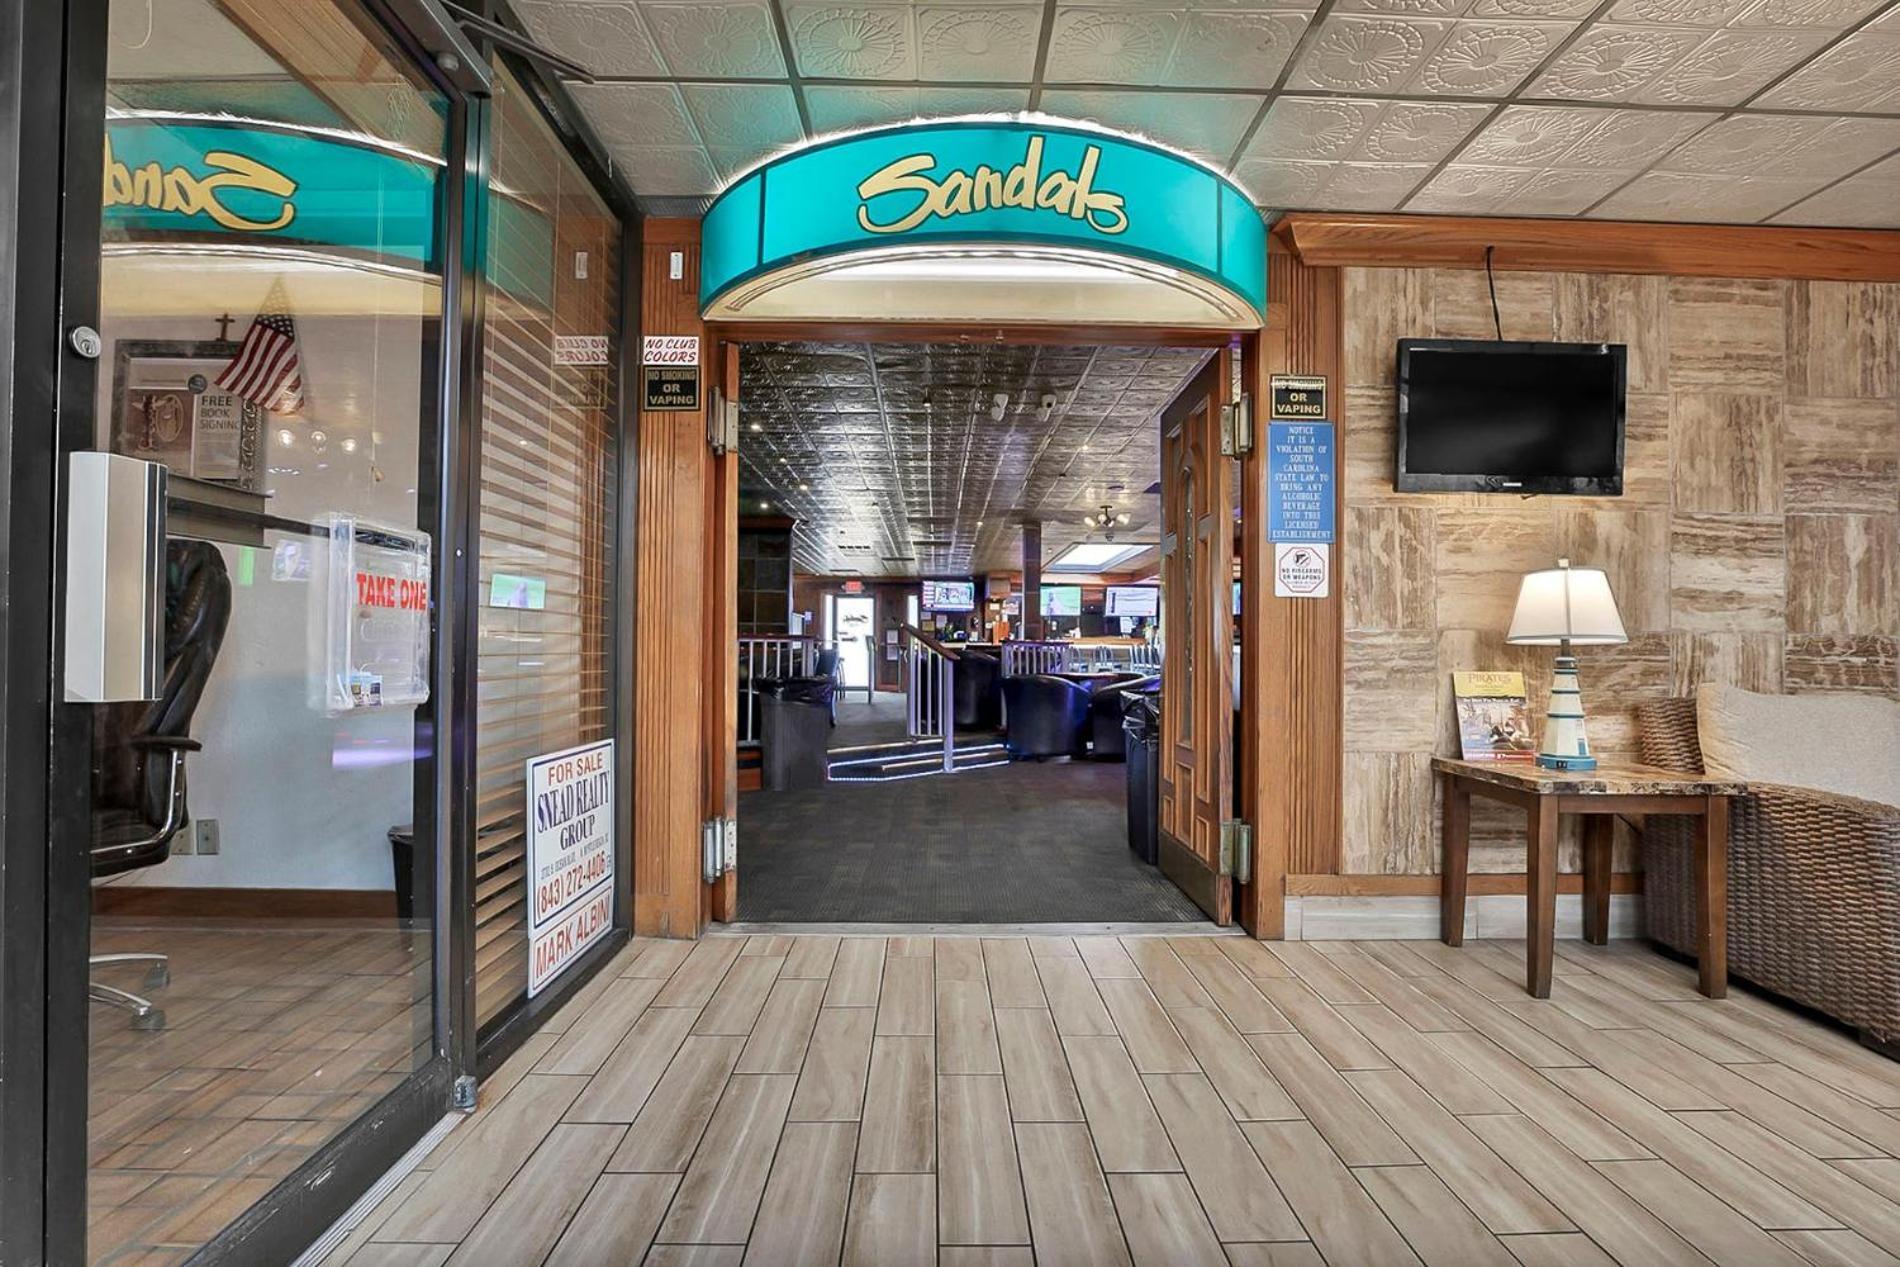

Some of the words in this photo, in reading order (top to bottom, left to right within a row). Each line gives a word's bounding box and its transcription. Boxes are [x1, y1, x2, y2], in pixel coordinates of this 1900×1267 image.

[857, 134, 1130, 235] Sandals
[645, 338, 663, 349] NO
[665, 338, 697, 349] CLUB
[644, 350, 697, 362] COLORS
[648, 370, 660, 380] NO
[661, 370, 696, 380] SMOKING
[663, 383, 680, 393] OR
[201, 395, 232, 407] FREE
[649, 395, 694, 405] VAPING
[1290, 392, 1308, 403] OR
[201, 408, 231, 418] BOOK
[1277, 404, 1321, 414] VAPING
[1289, 426, 1313, 435] NOTICE
[1287, 435, 1295, 444] IT
[1299, 435, 1306, 444] IS
[1310, 436, 1316, 444] A
[1290, 454, 1314, 463] SOUTH
[1283, 464, 1320, 473] CAROLINA
[356, 572, 396, 608] TAKE
[400, 579, 427, 611] ONE
[548, 762, 574, 786] FOR
[577, 752, 603, 776] SALE
[537, 783, 575, 834] SNEAD
[576, 770, 609, 817] REALTY
[560, 814, 596, 850] GROUP
[536, 874, 564, 920] (843)
[536, 922, 573, 979] MARK
